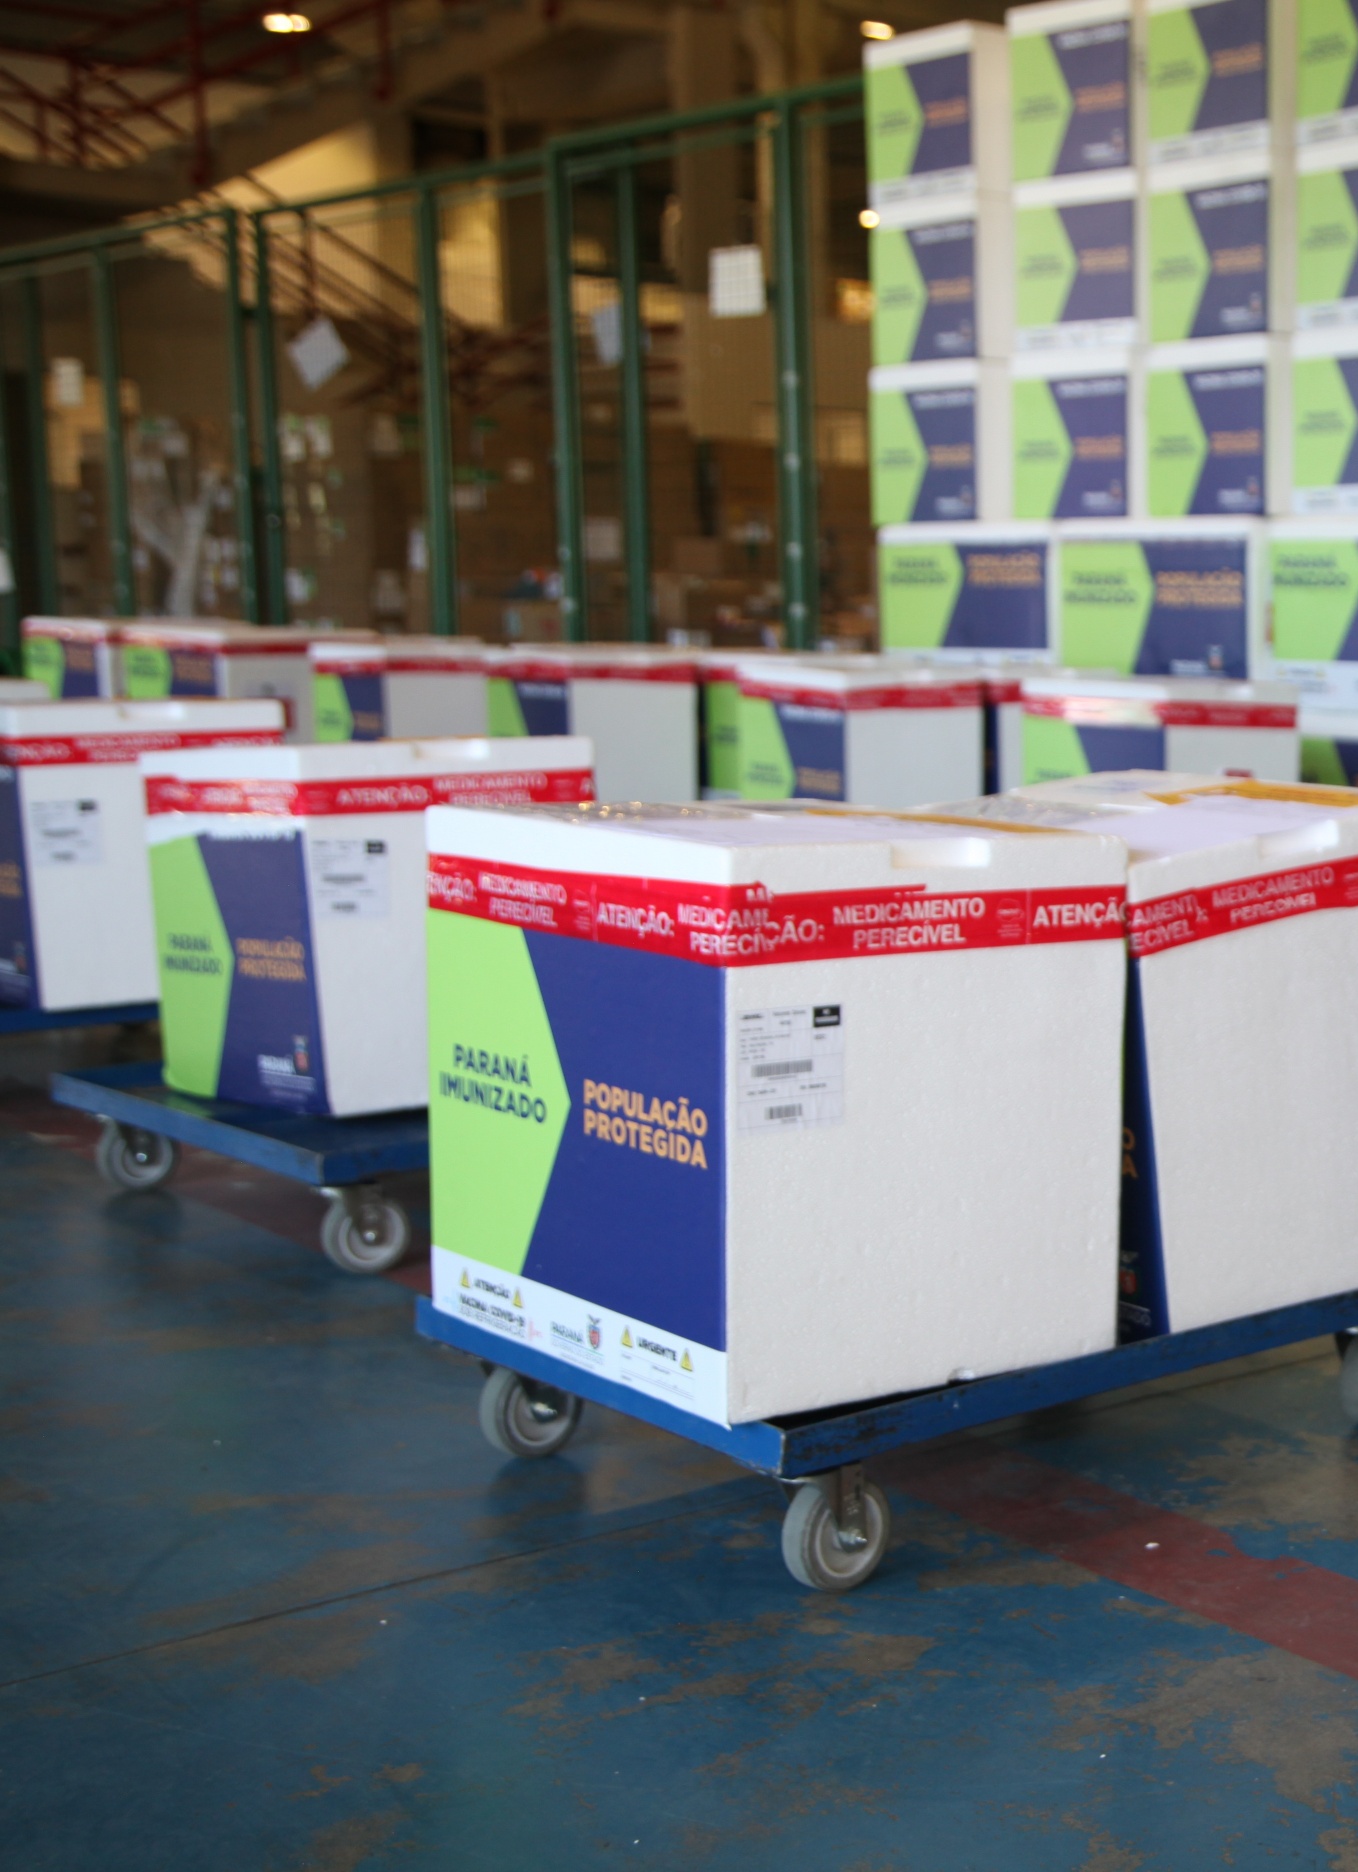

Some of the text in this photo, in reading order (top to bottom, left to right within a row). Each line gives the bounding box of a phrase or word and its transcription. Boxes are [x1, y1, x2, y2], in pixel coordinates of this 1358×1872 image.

[1211, 865, 1335, 909] MEDICAMENTO
[597, 901, 675, 939] ATENÇÃO:
[832, 896, 986, 926] MEDICAMENTO
[852, 919, 967, 950] PERECÍVEL
[453, 1042, 531, 1088] PARANÁ
[439, 1071, 547, 1124] IMUNIZADO
[582, 1078, 708, 1137] POPULAÇÃO
[582, 1108, 708, 1170] PROTEGIDA
